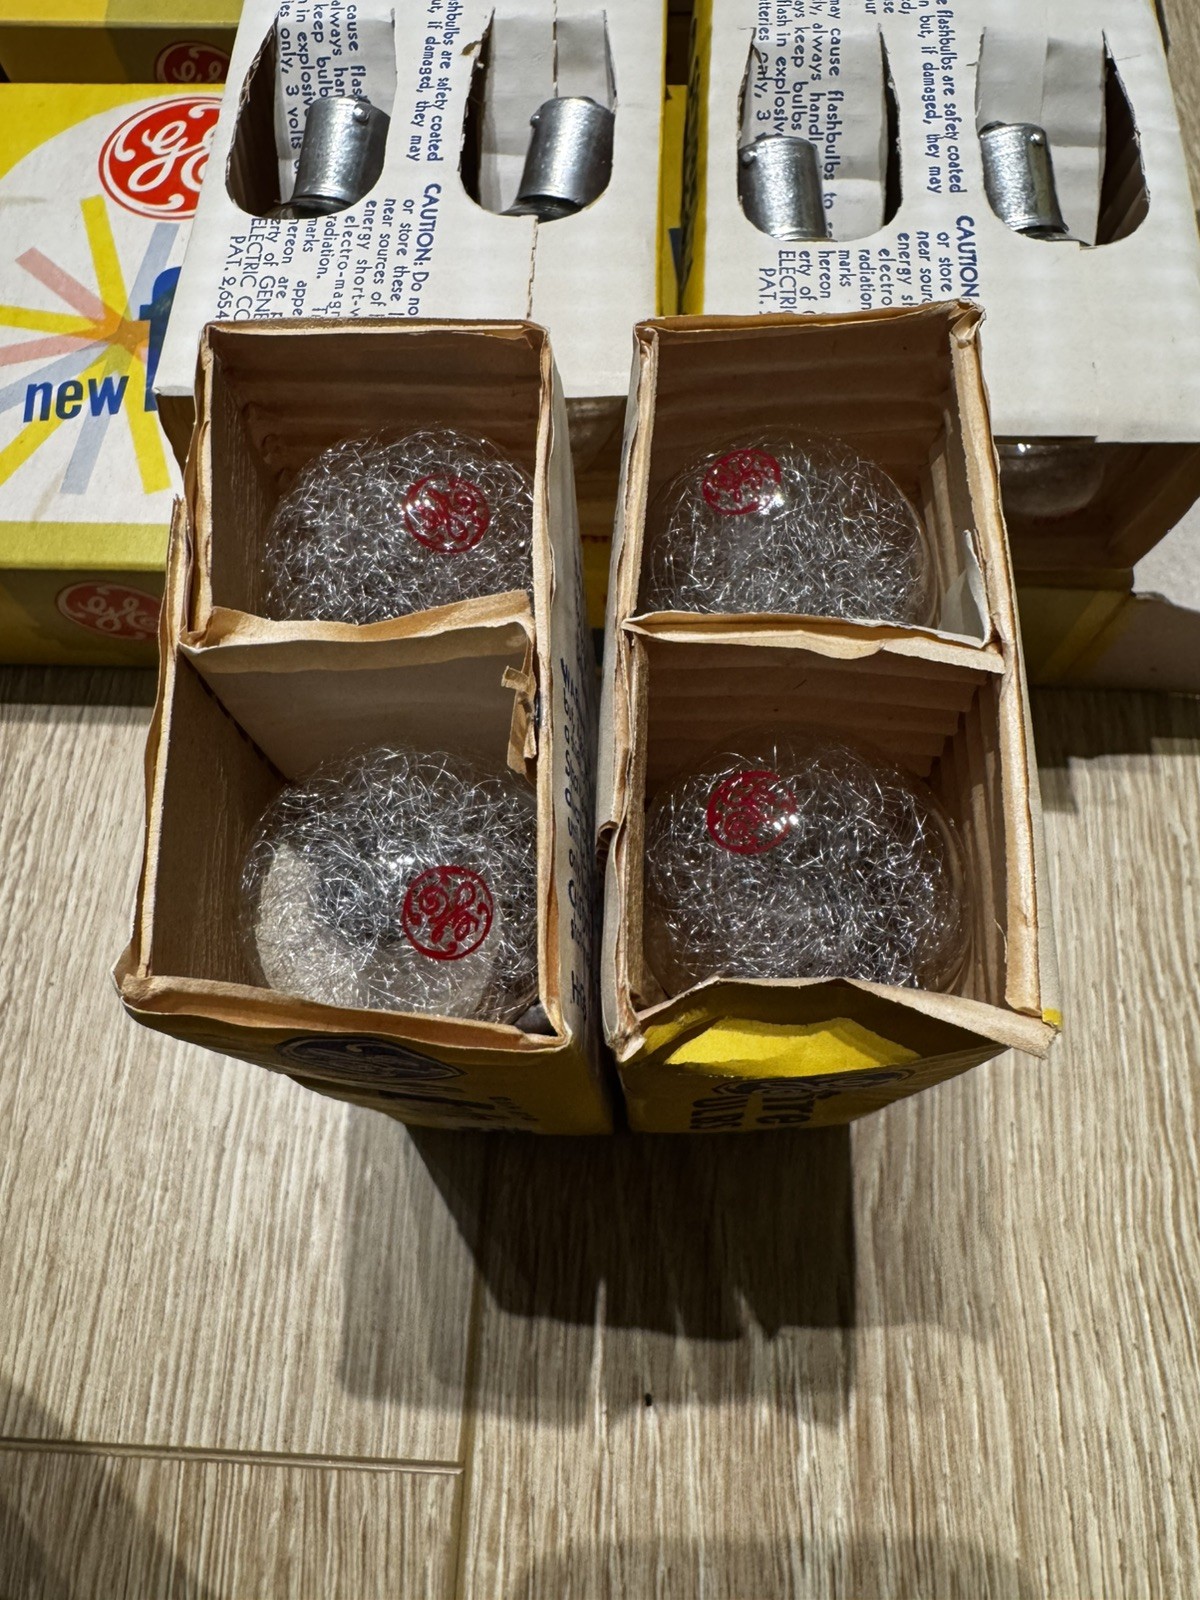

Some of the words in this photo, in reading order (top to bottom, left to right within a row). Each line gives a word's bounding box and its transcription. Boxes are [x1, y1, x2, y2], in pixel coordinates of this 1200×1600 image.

[296, 10, 310, 22] in
[311, 4, 329, 43] keep
[328, 0, 345, 56] always
[346, 4, 359, 52] cause
[427, 21, 443, 29] if
[917, 15, 936, 38] but,
[280, 28, 296, 74] only,
[776, 33, 791, 47] in
[791, 27, 811, 67] keep
[808, 23, 828, 81] always
[828, 28, 841, 76] cause
[921, 46, 938, 55] if
[936, 10, 957, 71] flashbulbs
[296, 31, 316, 113] explosiv
[416, 36, 441, 93] damaged,
[439, 51, 452, 69] are
[286, 85, 300, 96] 3
[430, 77, 452, 110] safety
[773, 56, 791, 134] explosiv
[921, 62, 943, 124] damaged,
[941, 75, 955, 96] are
[410, 100, 433, 127] they
[756, 110, 771, 121] 3
[791, 81, 809, 130] bulbs
[942, 103, 962, 140] safety
[287, 107, 304, 149] volts
[426, 115, 444, 161] coated
[823, 90, 845, 180] flashbulbs
[925, 133, 945, 158] they
[405, 135, 422, 161] may
[926, 166, 942, 193] may
[947, 145, 967, 193] coated
[357, 200, 377, 250] energy
[382, 198, 397, 227] near
[402, 199, 415, 215] or
[413, 182, 442, 266] CAUTION:
[224, 235, 246, 271] PAT.
[240, 218, 268, 287] ELECTRIC
[302, 218, 320, 253] marks
[316, 216, 340, 279] radiation.
[396, 222, 413, 256] store
[916, 230, 931, 262] near
[936, 232, 950, 248] or
[262, 252, 279, 267] of
[373, 233, 390, 285] sources
[797, 250, 813, 276] erty
[817, 250, 837, 299] hereon
[838, 250, 857, 287] marks
[896, 232, 912, 285] energy
[938, 257, 954, 292] store
[955, 215, 980, 297] CAUTION
[276, 276, 289, 299] are
[390, 265, 410, 302] these
[410, 272, 429, 291] Do
[758, 268, 777, 305] PAT.
[778, 250, 797, 311] ELECTRI
[799, 286, 818, 301] of
[858, 249, 878, 310] radiation
[878, 248, 897, 306] electro
[370, 292, 387, 307] of
[23, 375, 129, 423] new
